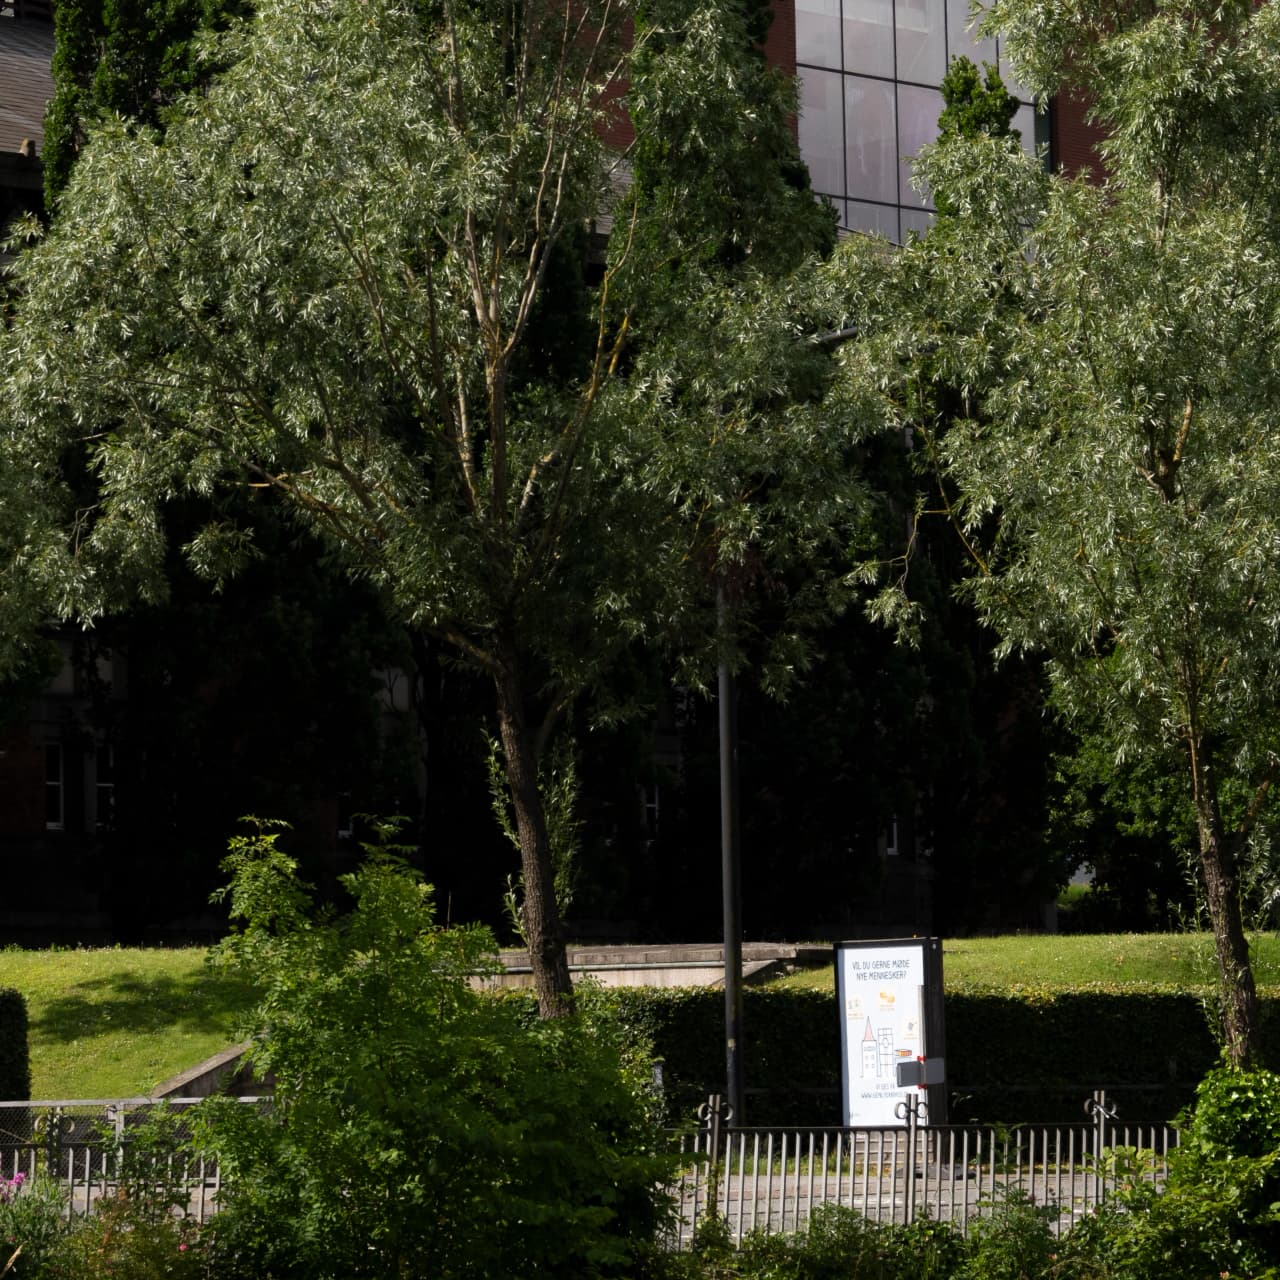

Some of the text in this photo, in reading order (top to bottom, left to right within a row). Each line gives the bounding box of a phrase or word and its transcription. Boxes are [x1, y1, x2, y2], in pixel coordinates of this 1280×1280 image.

[852, 959, 910, 970] VIL DU GERNE MØDE
[856, 970, 907, 981] NYE MENNESKER?
